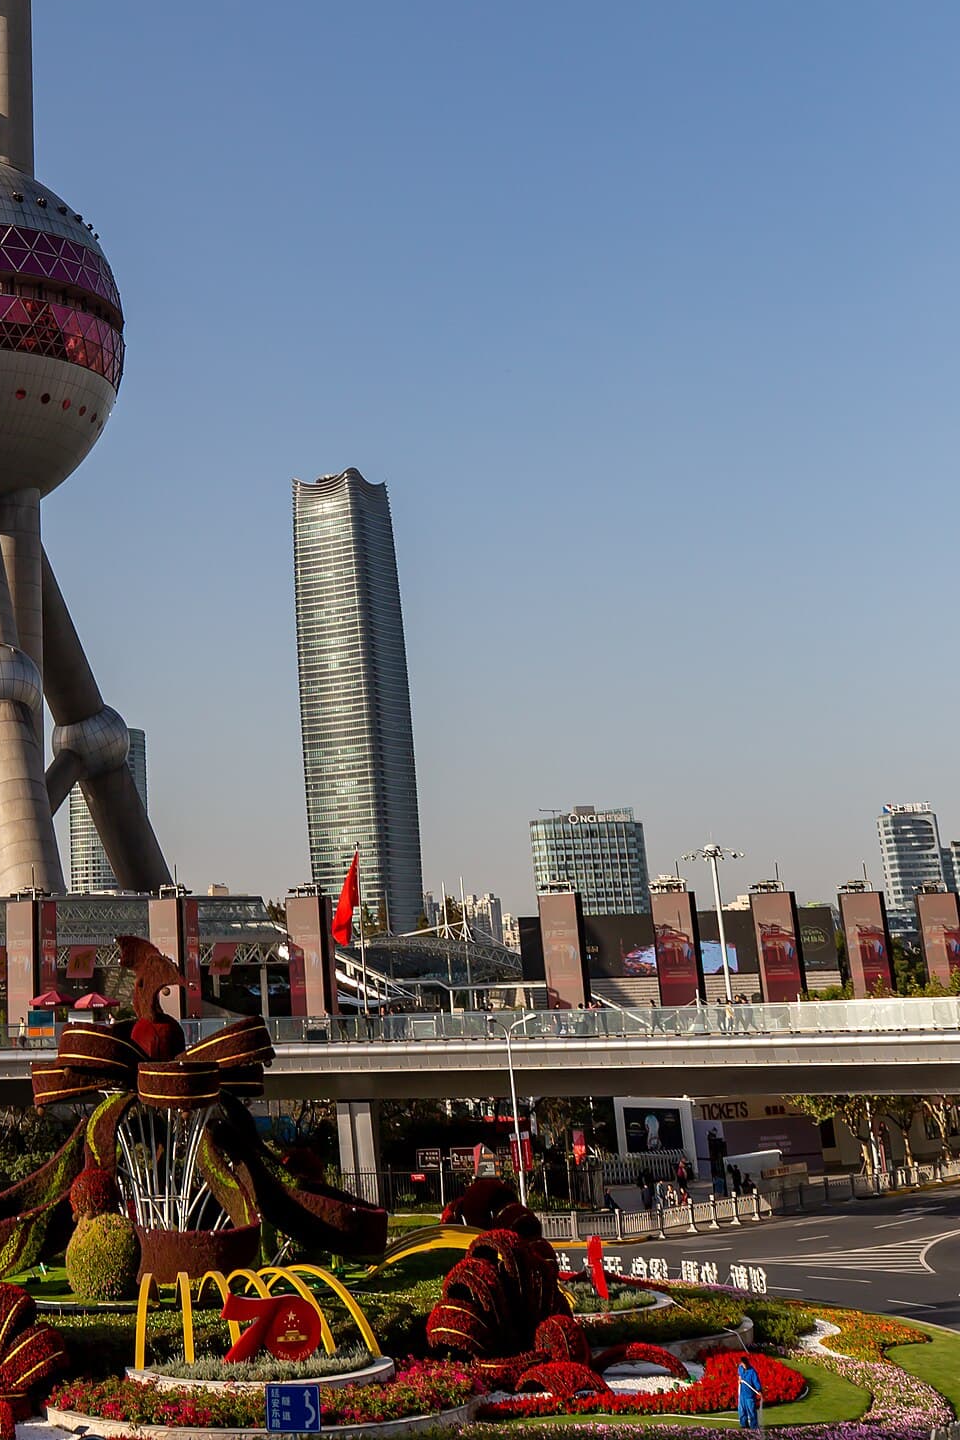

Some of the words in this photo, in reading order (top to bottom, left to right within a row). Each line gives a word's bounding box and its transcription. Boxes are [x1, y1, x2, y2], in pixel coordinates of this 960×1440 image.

[699, 1101, 749, 1120] TICKETS
[270, 1388, 281, 1429] 延安东路
[281, 1396, 292, 1421] 隧道
